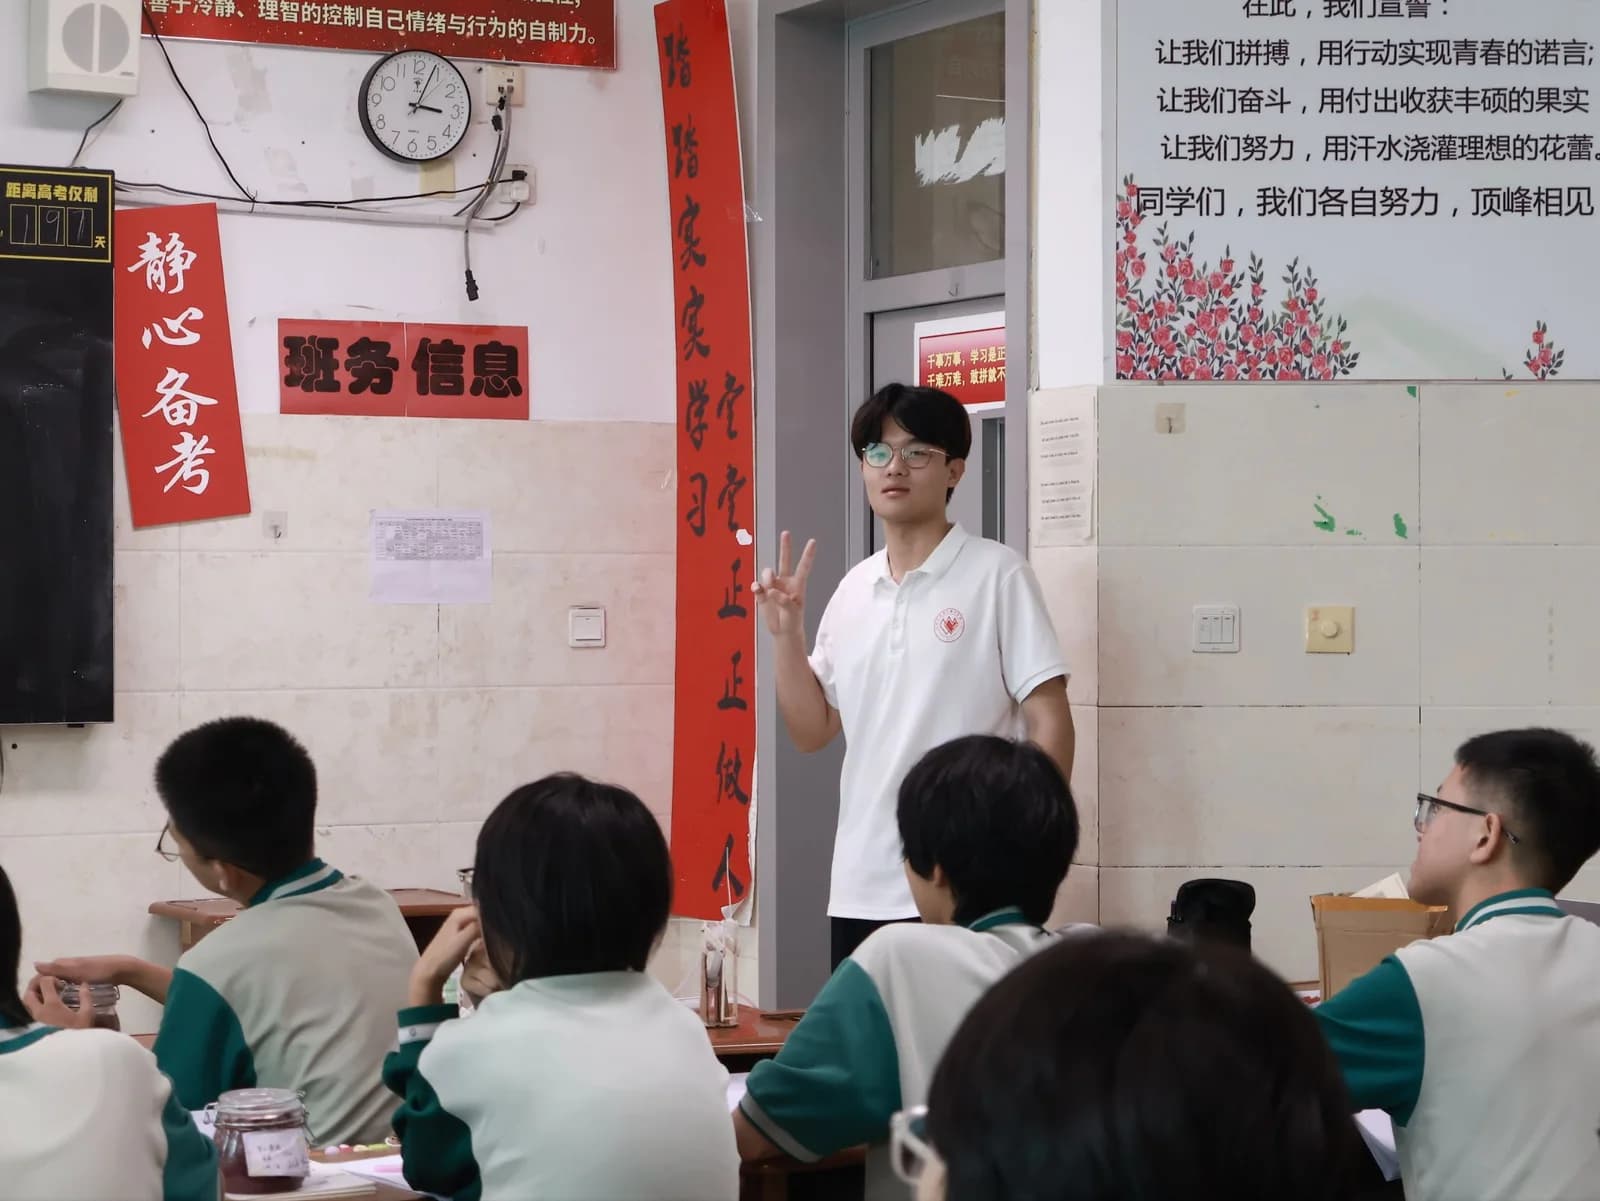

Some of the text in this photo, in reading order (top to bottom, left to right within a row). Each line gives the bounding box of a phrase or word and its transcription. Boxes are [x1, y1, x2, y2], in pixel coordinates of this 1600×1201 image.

[143, 0, 597, 45] 善于冷静、理智的控制自己情绪与行为的自制力。
[396, 62, 406, 78] 11
[413, 59, 426, 75] 12
[380, 75, 396, 91] 10
[444, 83, 456, 98] 2
[371, 93, 382, 107] 9
[1157, 86, 1590, 115] 让我们奋斗，用付出收获丰硕的果实
[450, 104, 460, 120] 3
[375, 114, 386, 130] 8
[391, 130, 401, 145] 7
[442, 124, 451, 139] 4
[407, 138, 418, 153] 6
[427, 136, 437, 151] 5
[5, 181, 99, 203] 距离高考仅剩
[1136, 186, 1595, 218] 同学们，我们各自努力，顶峰相见
[94, 236, 106, 248] 天
[127, 231, 218, 495] 静心备考
[283, 335, 523, 398] 班务信息
